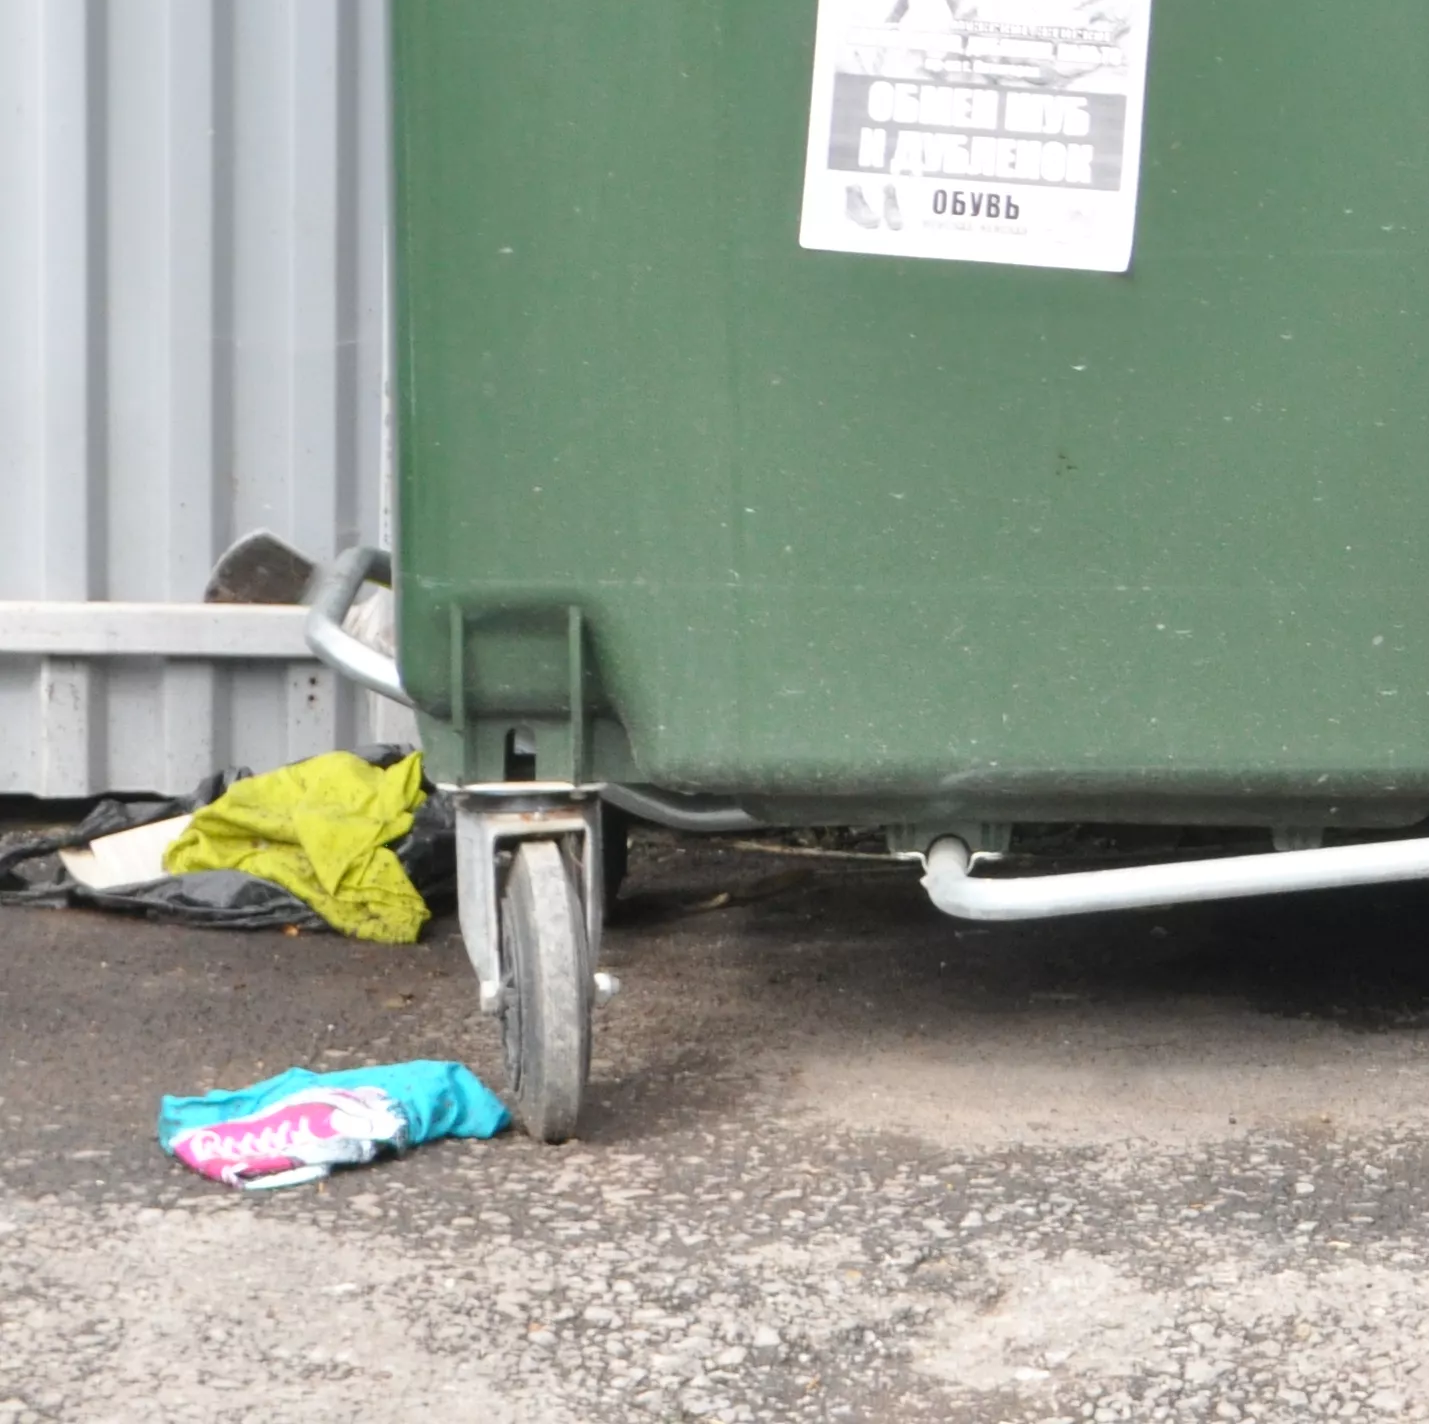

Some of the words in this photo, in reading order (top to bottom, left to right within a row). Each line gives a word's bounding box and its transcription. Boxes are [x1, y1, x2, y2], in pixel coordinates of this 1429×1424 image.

[867, 80, 999, 131] ОБМЕН
[1005, 91, 1092, 137] ШУБ
[858, 127, 887, 168] И
[890, 130, 1094, 184] ДУБЛЕНОК
[932, 188, 1021, 221] ОБУВЬ
